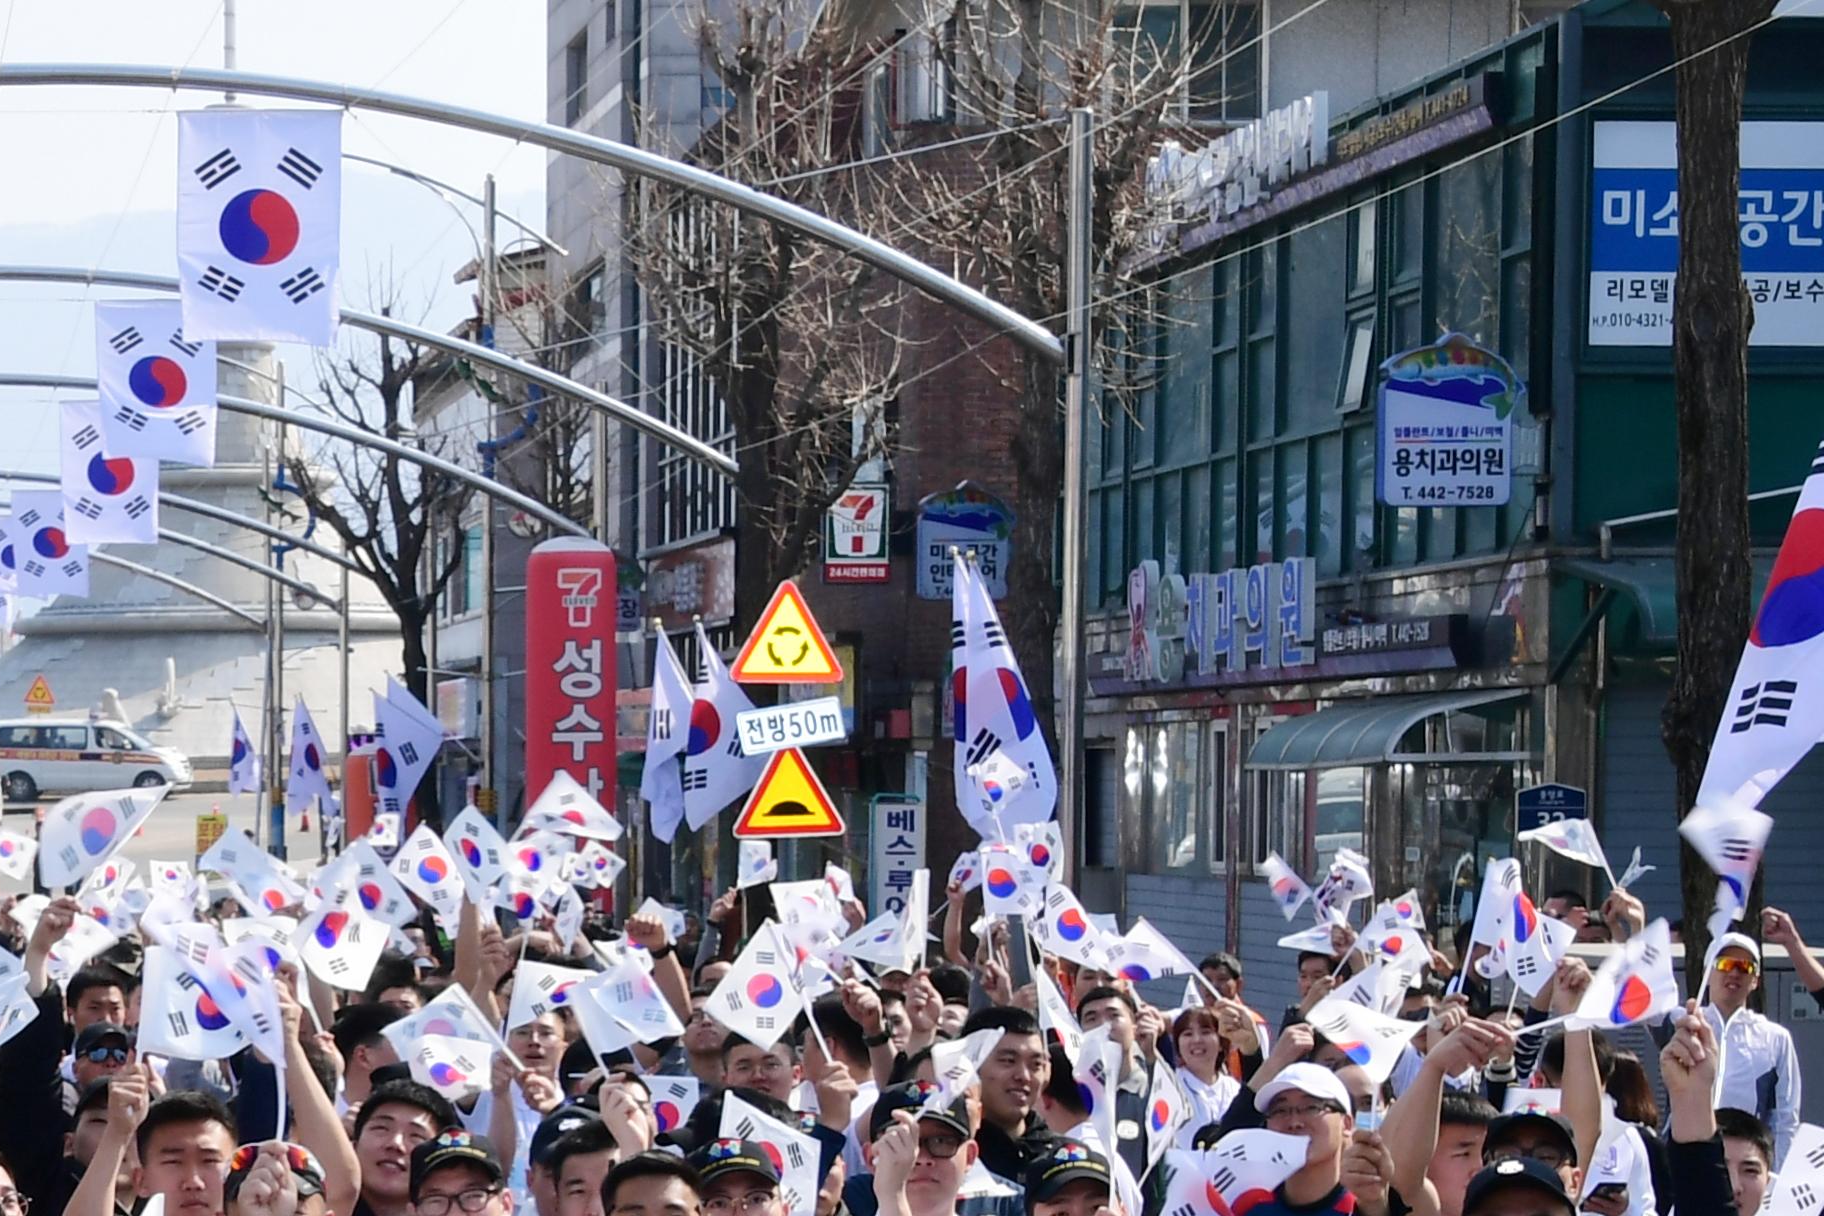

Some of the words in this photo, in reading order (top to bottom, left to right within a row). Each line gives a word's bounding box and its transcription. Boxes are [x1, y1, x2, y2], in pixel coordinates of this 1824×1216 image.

[1753, 278, 1824, 304] 공/보수
[1391, 448, 1504, 477] 용치과의원
[1401, 486, 1413, 500] T.
[1417, 485, 1494, 500] 442-7528
[1157, 556, 1303, 682] 용치과의원
[745, 710, 839, 746] 전방50m
